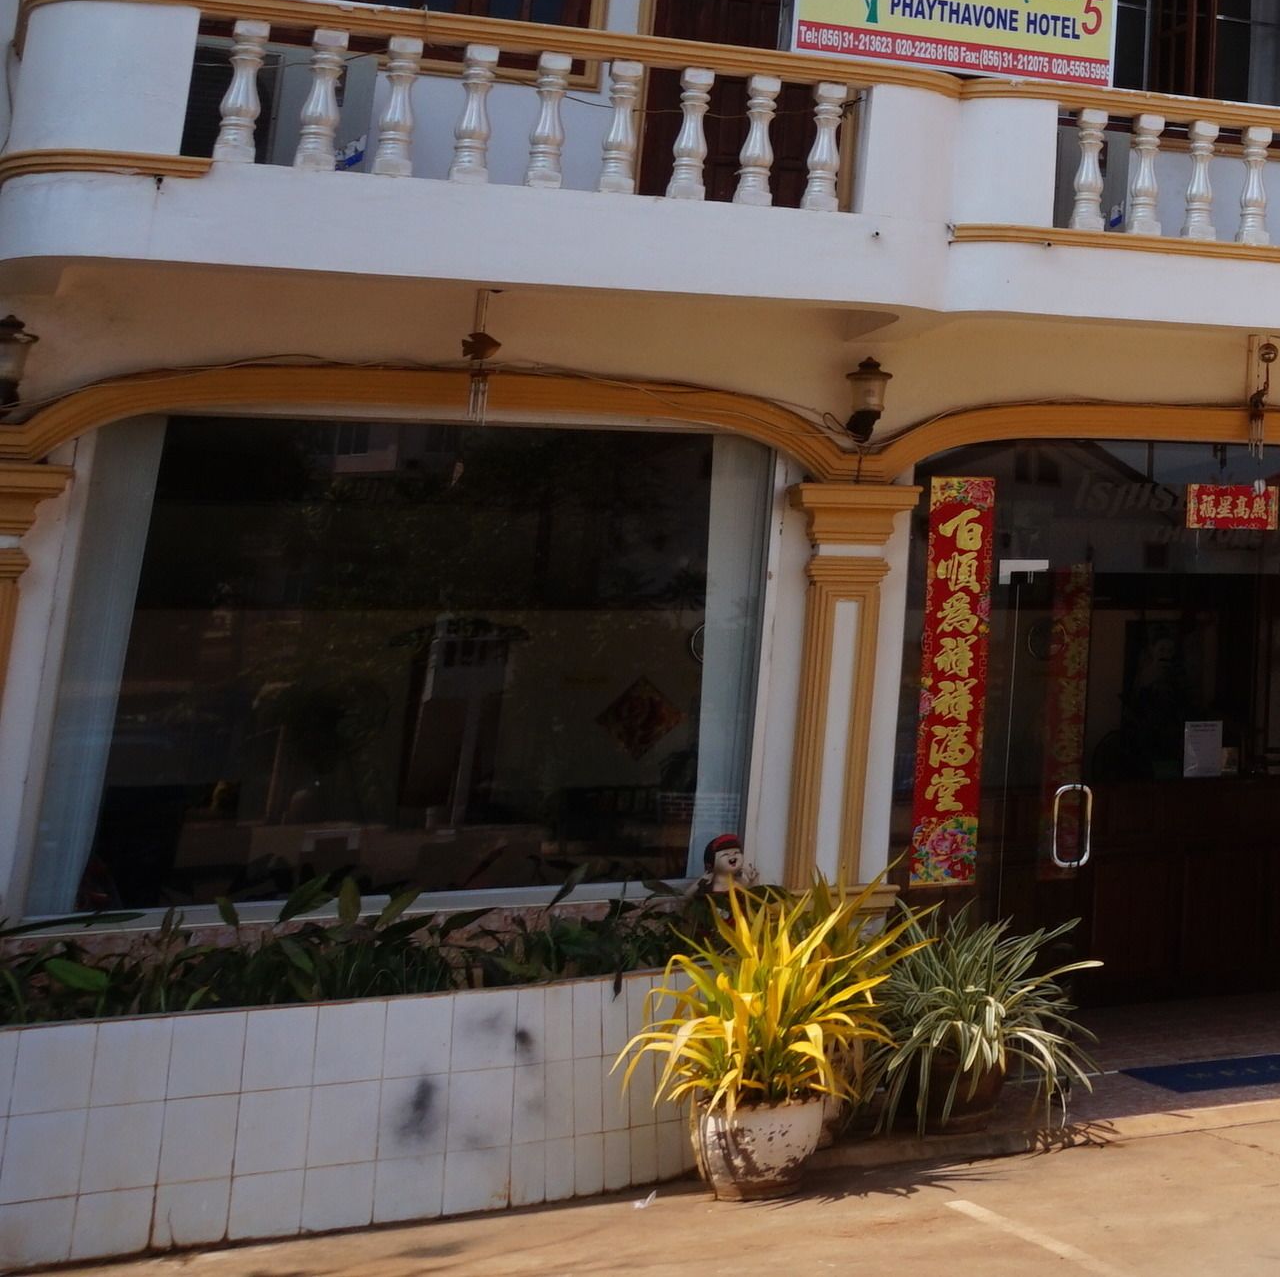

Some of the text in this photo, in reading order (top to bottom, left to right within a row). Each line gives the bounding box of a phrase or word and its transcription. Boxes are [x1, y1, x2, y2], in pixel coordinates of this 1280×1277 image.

[1026, 11, 1081, 40] HOTEL
[895, 39, 959, 62] 020-22268168
[1199, 494, 1268, 520] 福星高照
